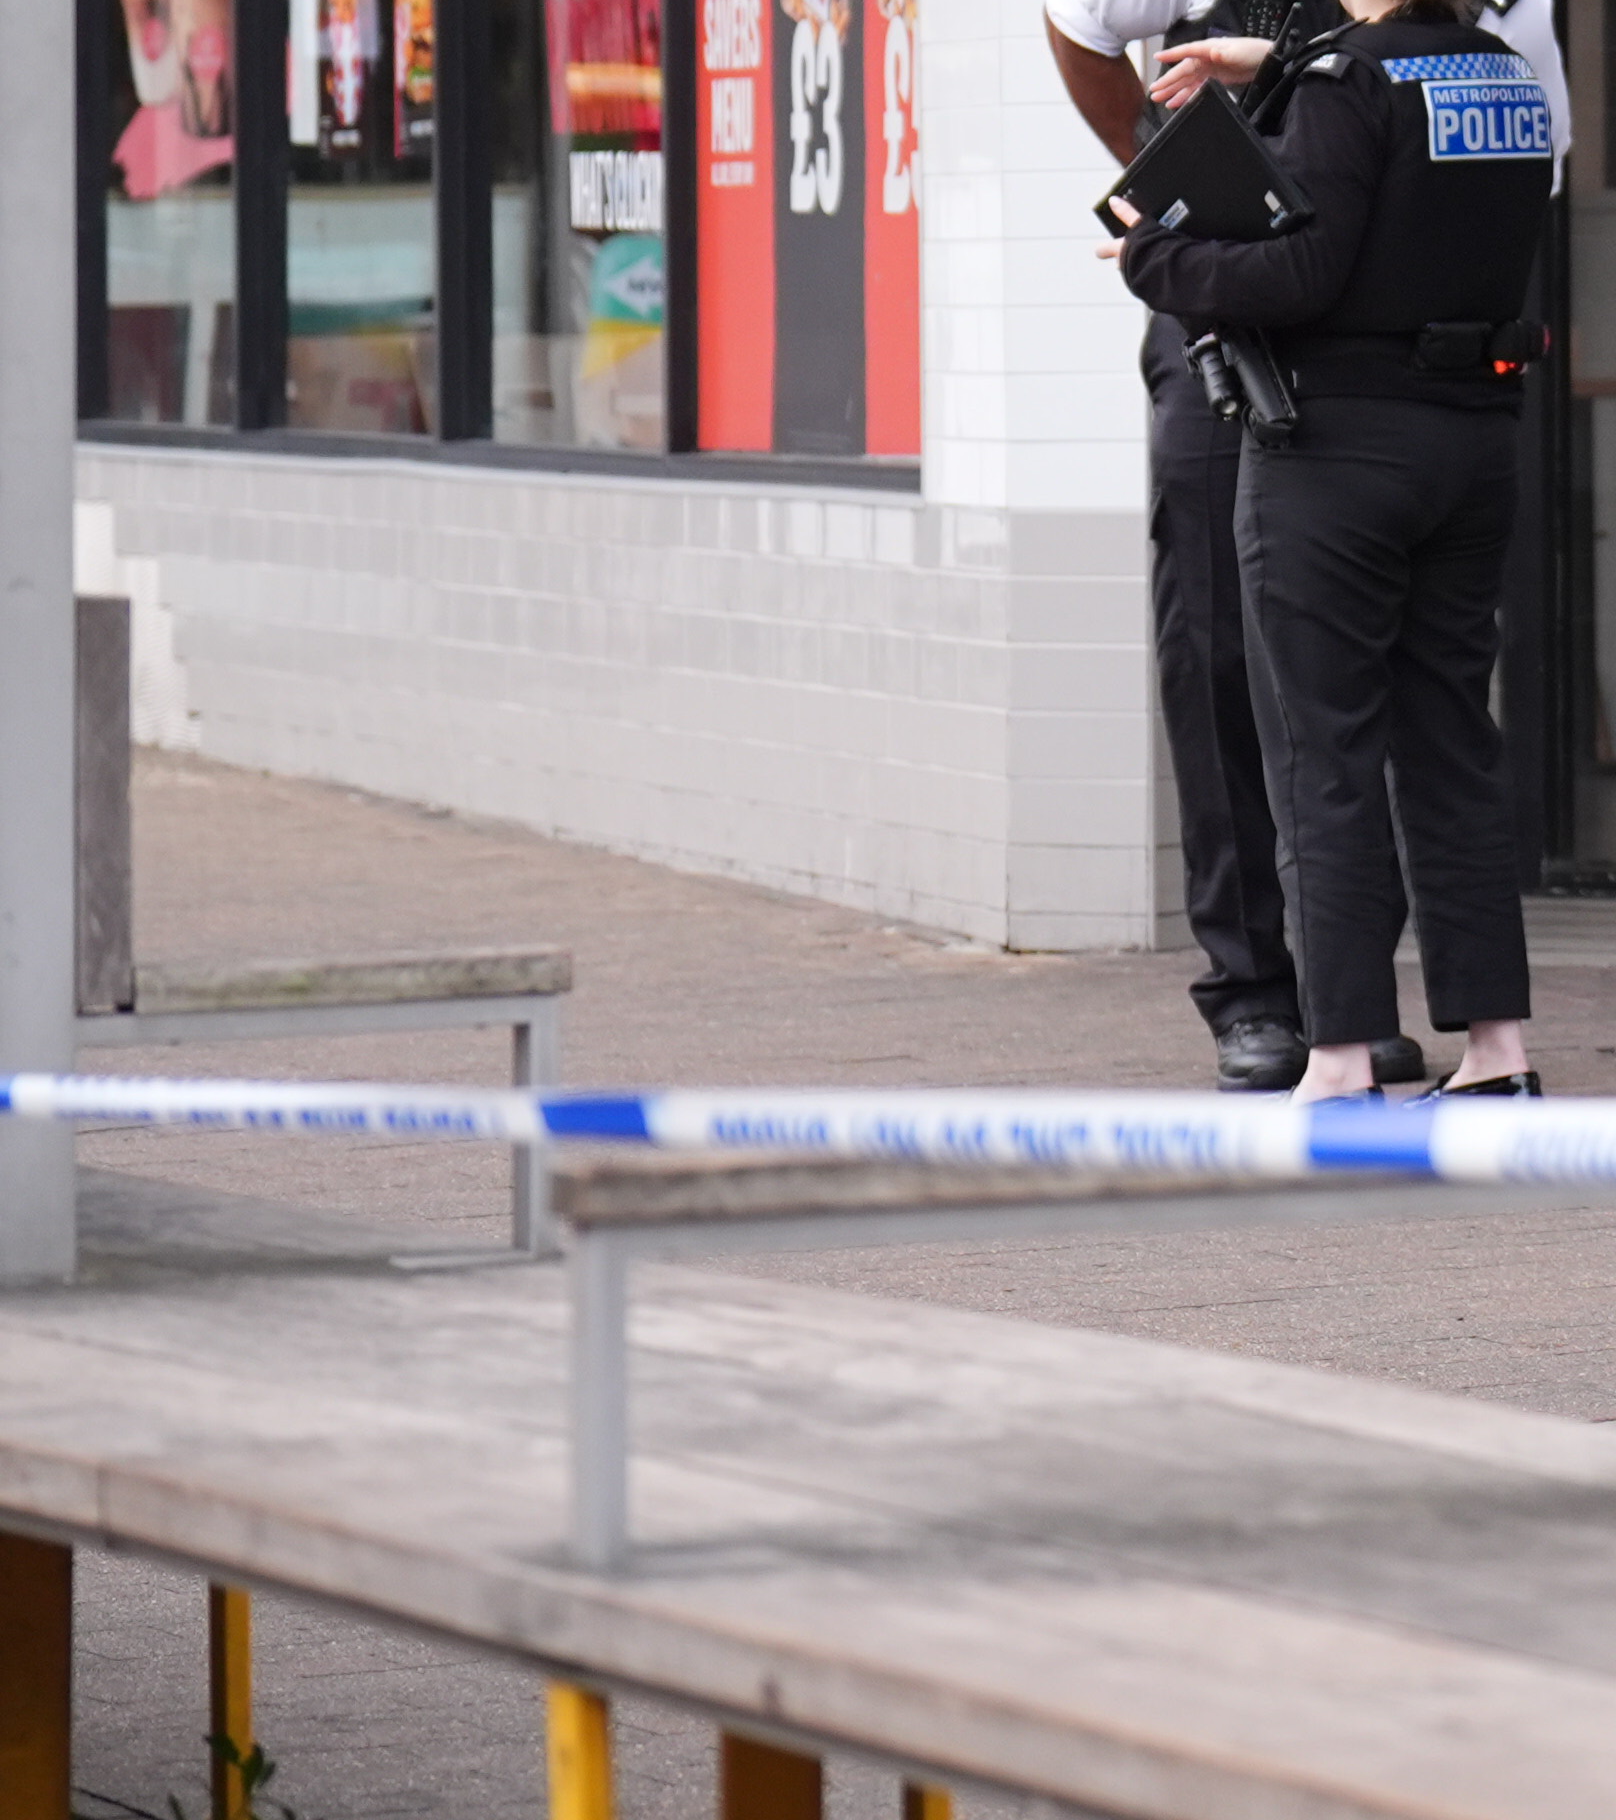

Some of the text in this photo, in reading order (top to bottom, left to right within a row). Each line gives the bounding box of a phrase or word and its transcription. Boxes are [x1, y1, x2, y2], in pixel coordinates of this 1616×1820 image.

[711, 78, 755, 154] MENU
[790, 17, 842, 217] £3
[1433, 87, 1544, 104] METROPOLITAN
[1436, 106, 1548, 151] POLICE
